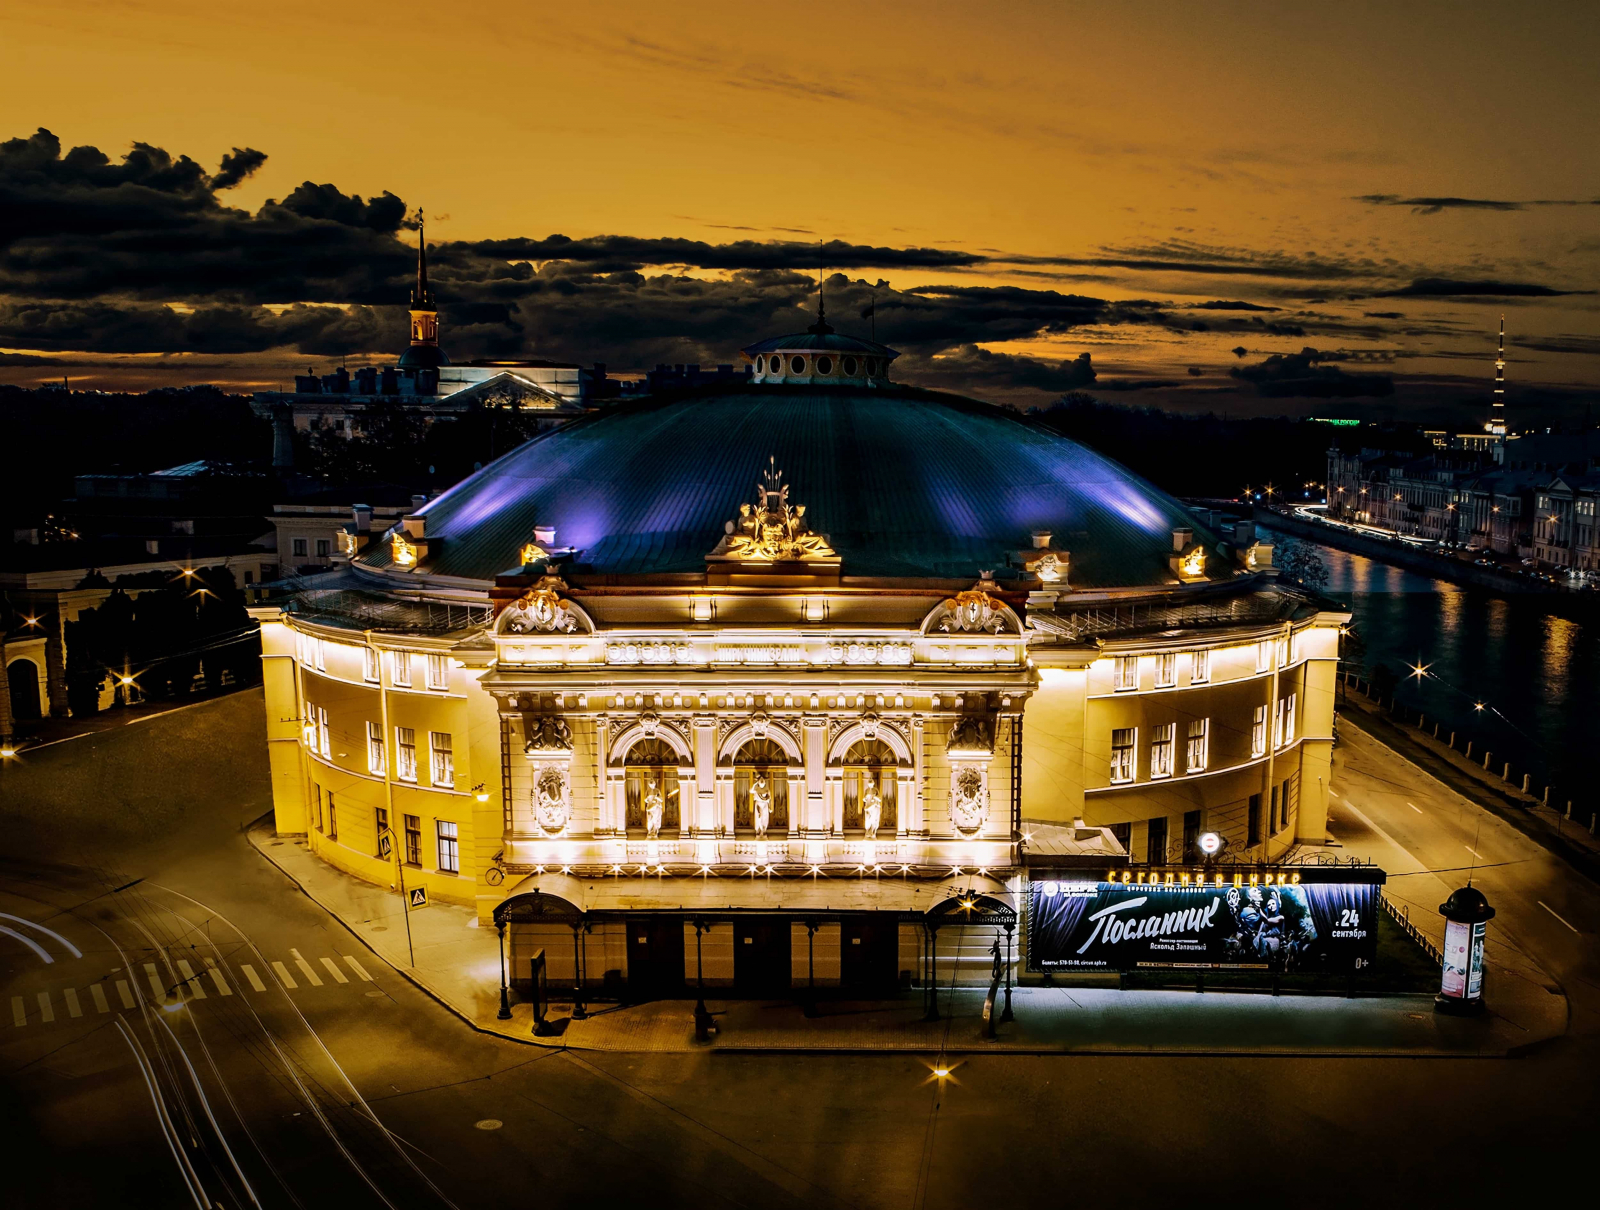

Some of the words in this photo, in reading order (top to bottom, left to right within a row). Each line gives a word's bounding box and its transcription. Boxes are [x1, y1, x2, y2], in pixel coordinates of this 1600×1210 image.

[1076, 896, 1220, 954] Посланник
[1340, 909, 1359, 927] 24
[1332, 928, 1367, 940] сентября
[1355, 957, 1369, 969] 0+
